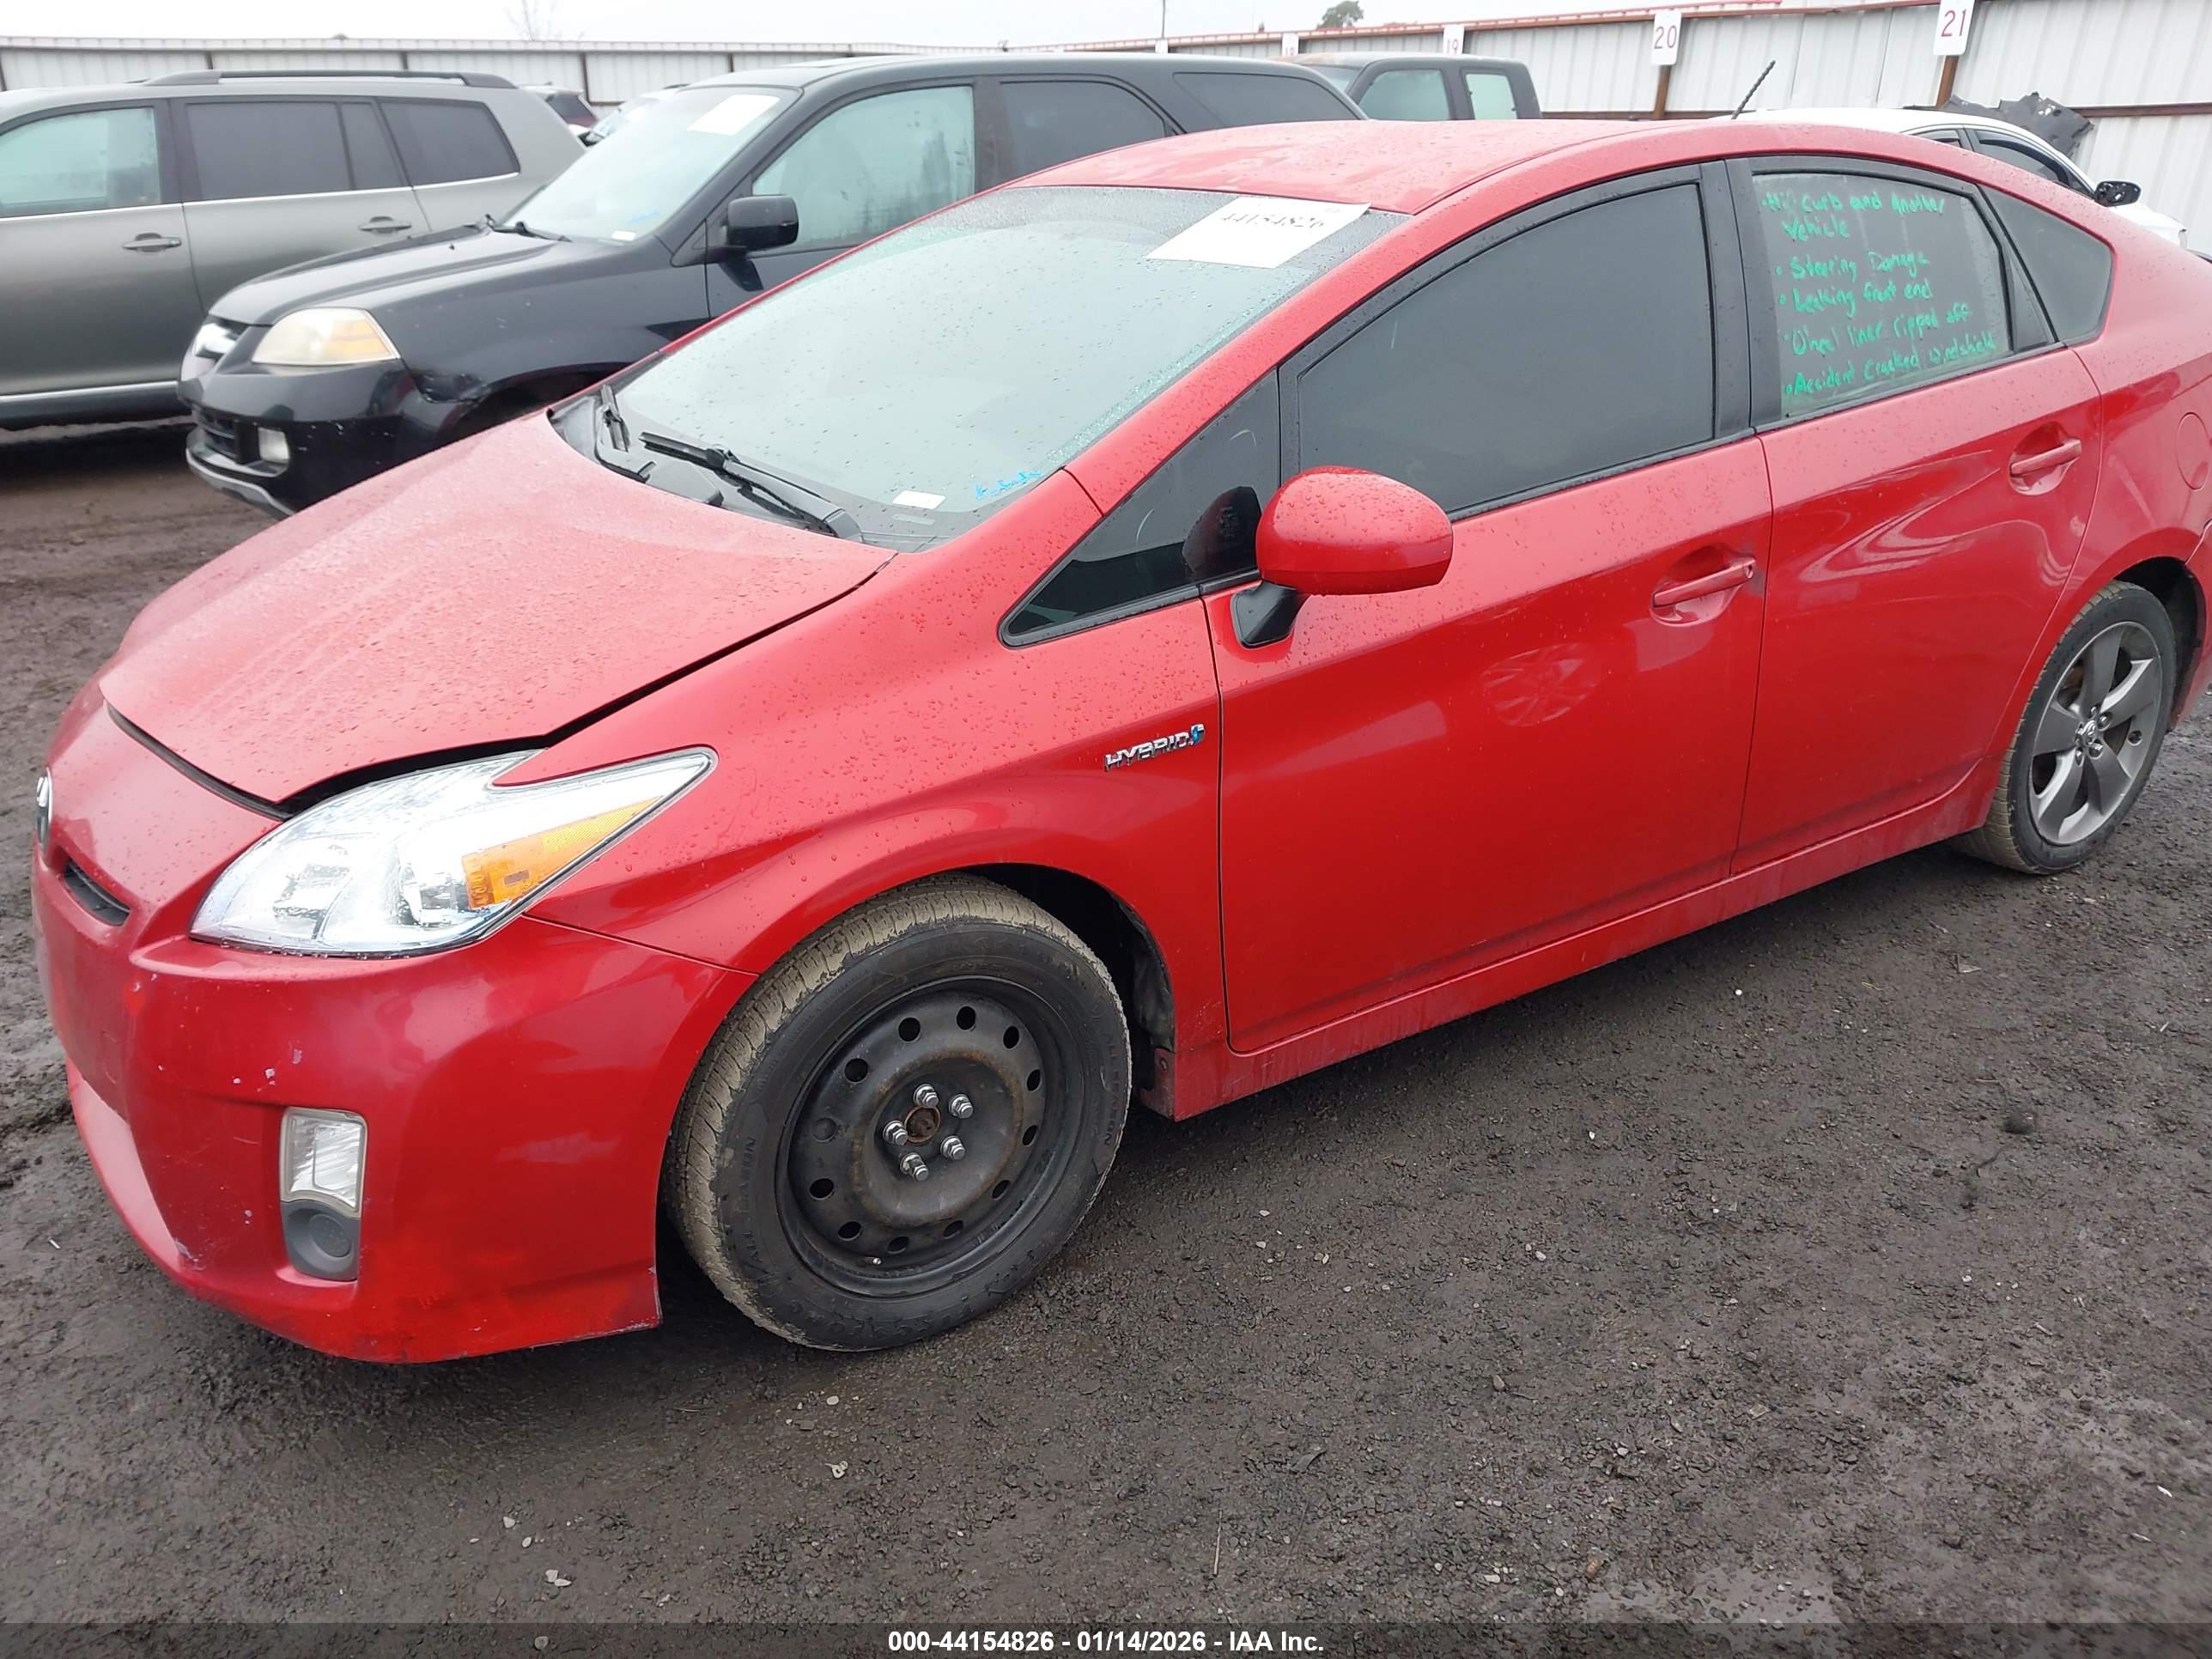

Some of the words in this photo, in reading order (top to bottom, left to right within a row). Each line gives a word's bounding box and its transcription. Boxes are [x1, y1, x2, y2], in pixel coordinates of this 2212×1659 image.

[1942, 9, 1968, 38] 21
[1654, 25, 1678, 49] 20
[1802, 191, 1843, 212] Curb
[1849, 191, 1882, 210] and
[1781, 213, 1850, 241] Vehicle
[1867, 250, 1930, 278] Damage
[1903, 277, 1934, 300] end
[1946, 302, 1971, 324] off
[1104, 731, 1190, 772] HYBRID
